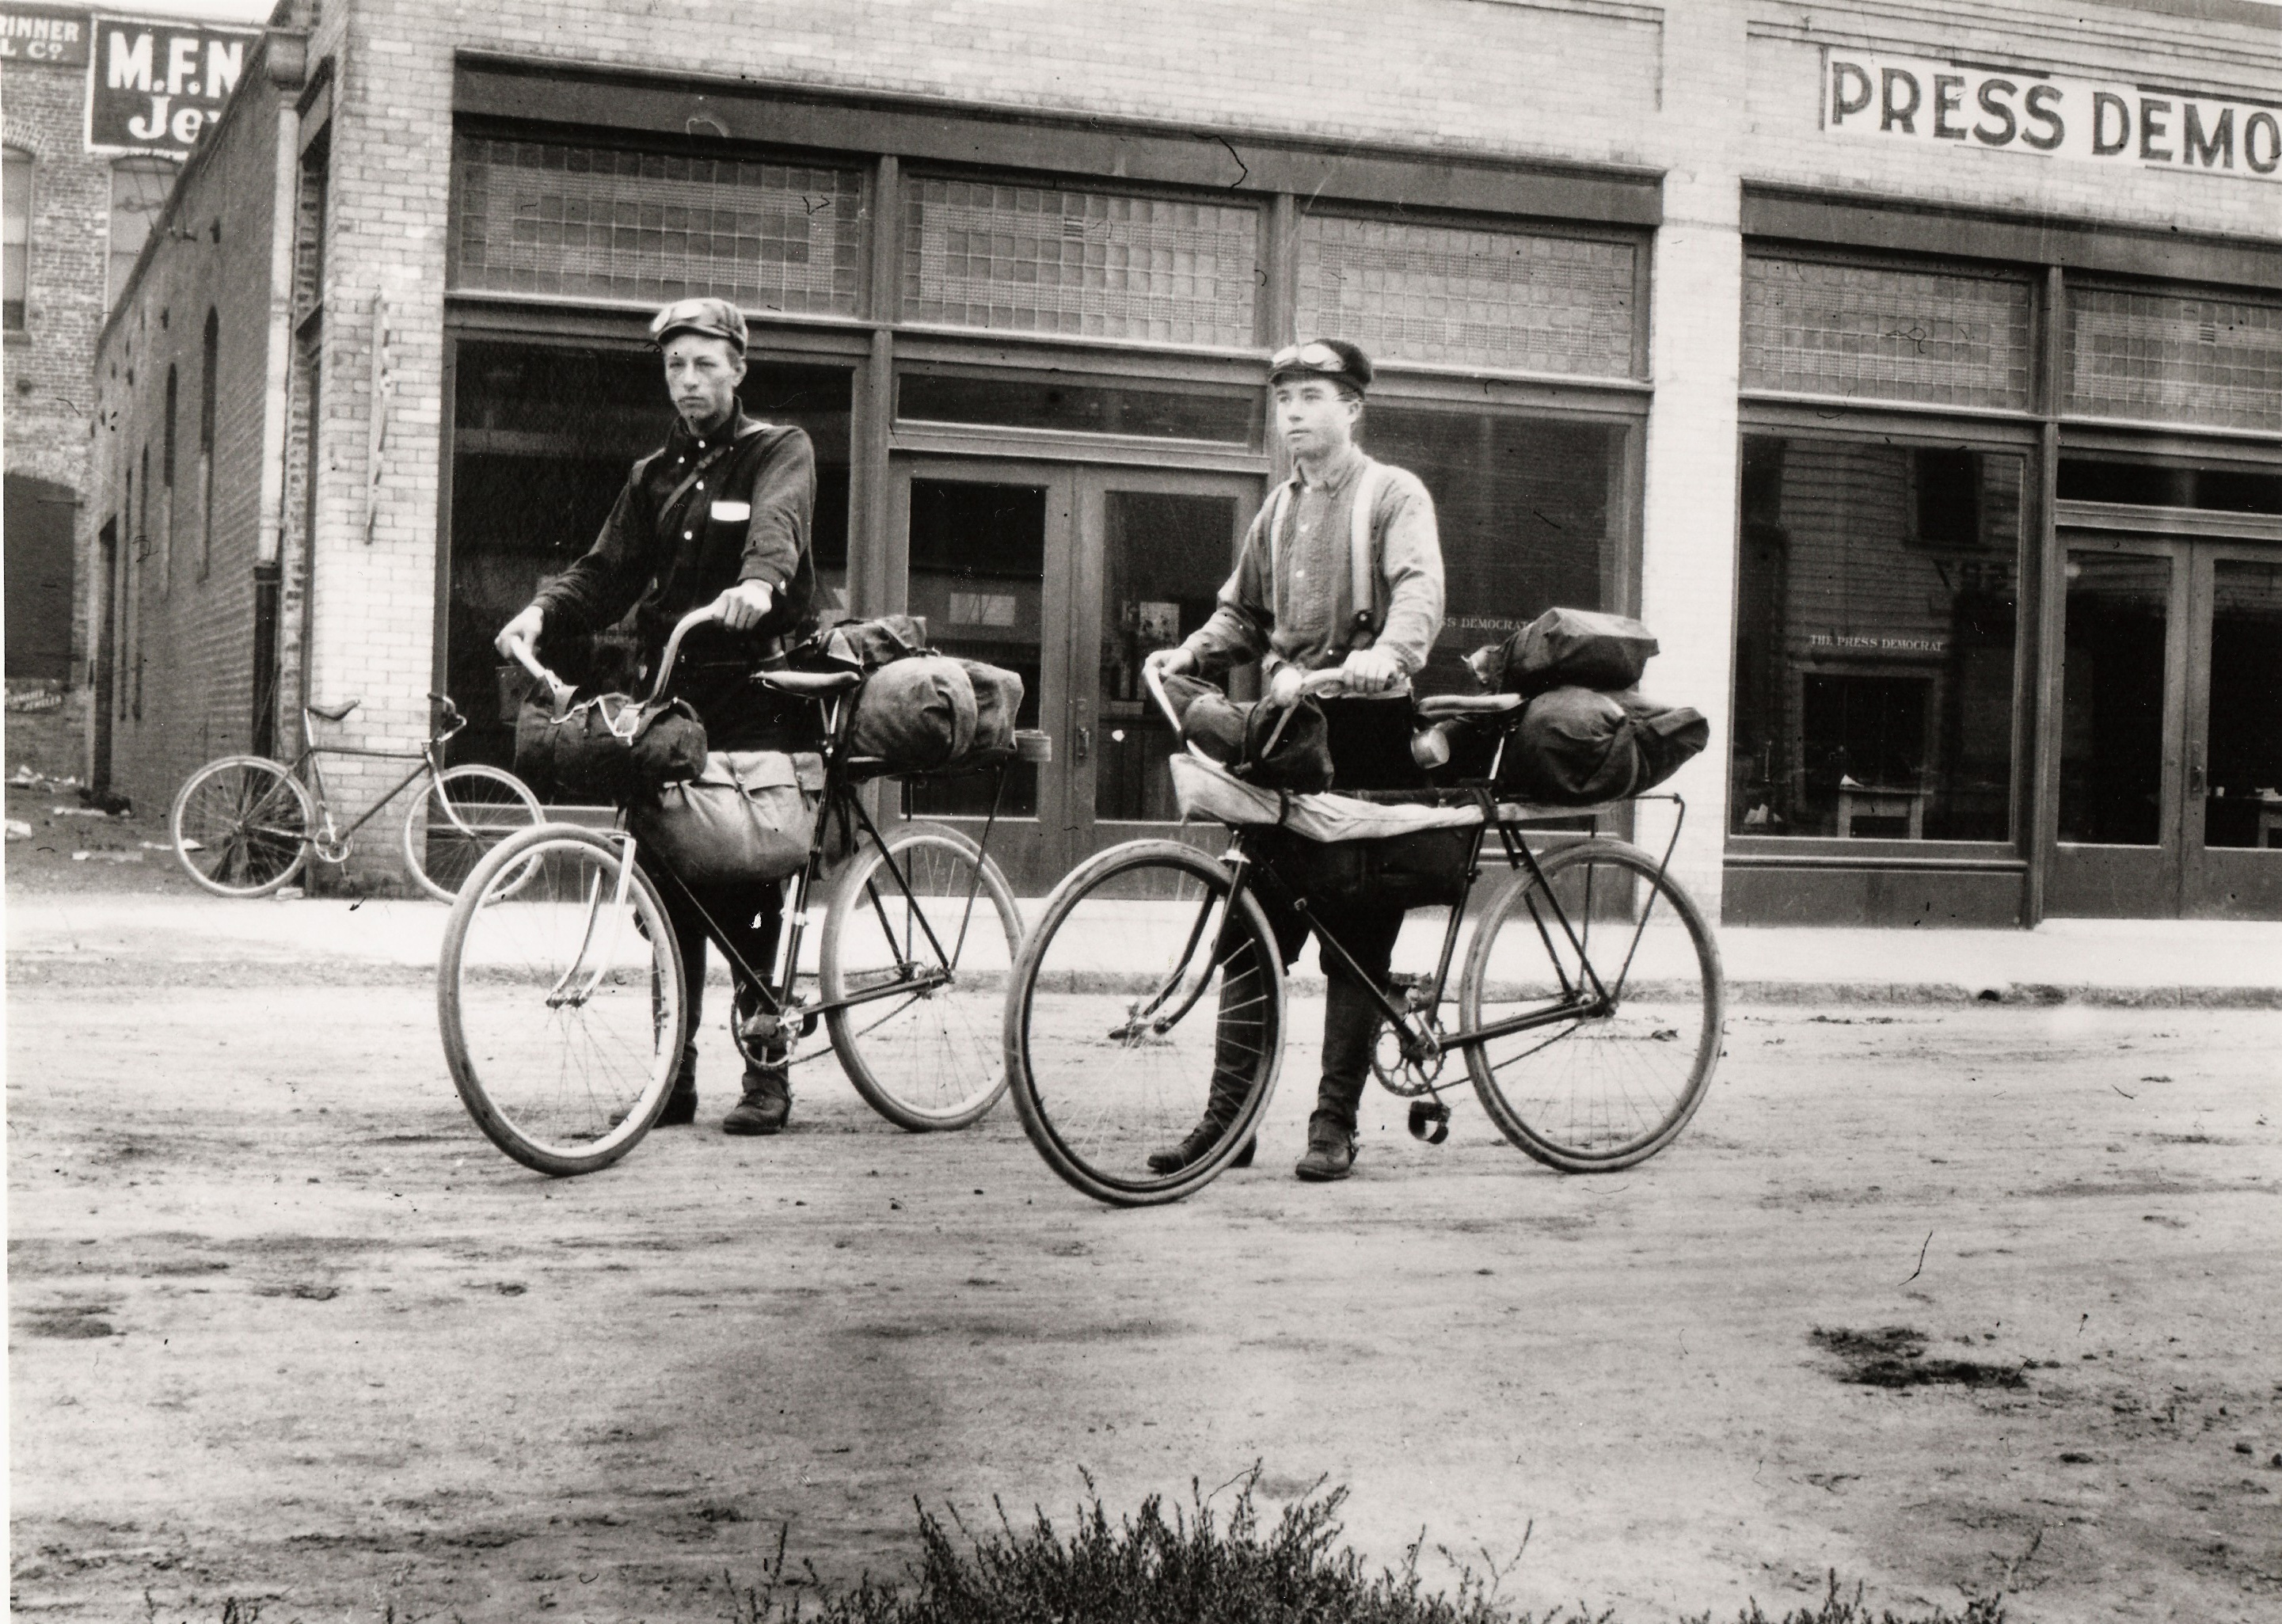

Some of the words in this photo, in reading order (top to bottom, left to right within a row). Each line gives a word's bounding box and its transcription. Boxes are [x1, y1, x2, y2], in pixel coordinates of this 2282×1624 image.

[1831, 61, 2065, 151] PRESS
[2092, 91, 2281, 174] DEMO
[1462, 618, 1530, 631] DEMOCRAT
[1810, 634, 1833, 646] THE
[1837, 636, 1877, 648] PRESS
[1881, 638, 1944, 652] DEMOCRAT
